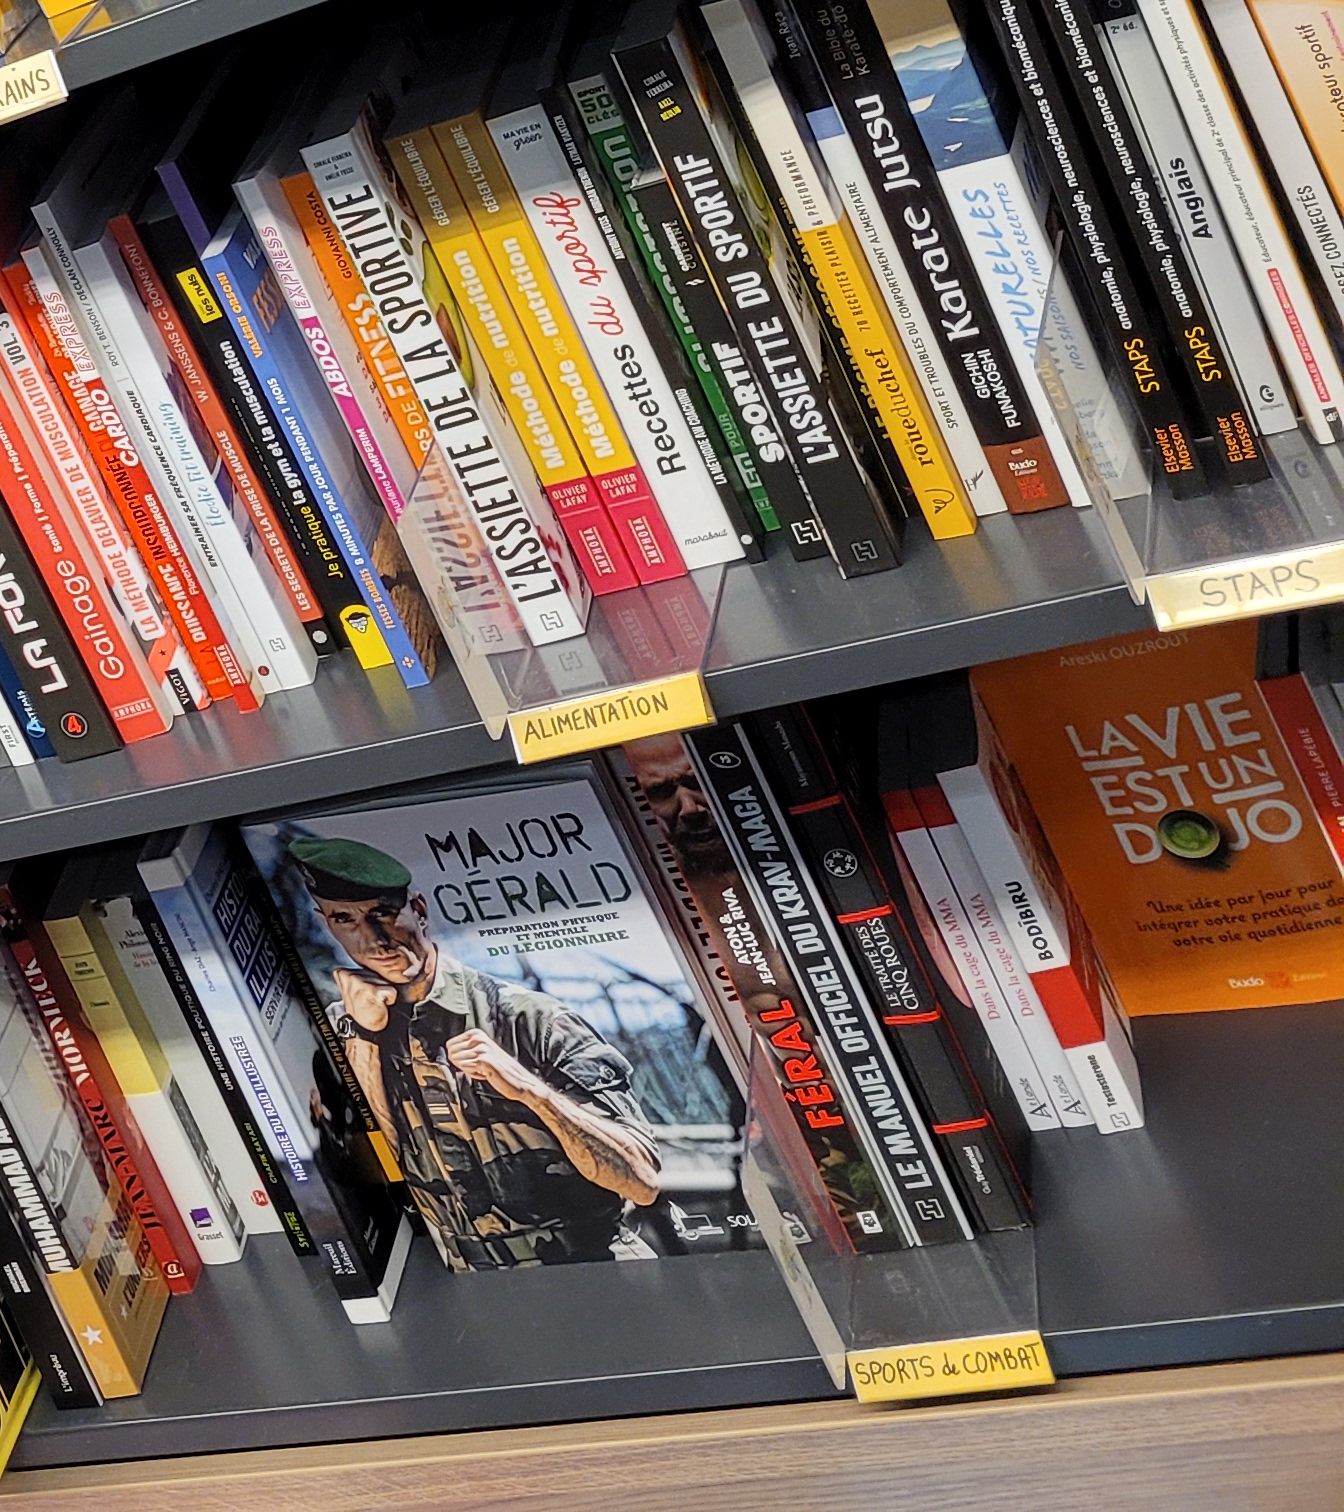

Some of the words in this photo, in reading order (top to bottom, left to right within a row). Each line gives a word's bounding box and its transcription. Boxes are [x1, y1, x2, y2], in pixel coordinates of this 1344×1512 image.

[854, 94, 913, 193] Jutsu
[533, 190, 609, 287] sportif
[677, 154, 748, 267] SPORTIF
[328, 185, 430, 343] SPORTIVE
[734, 273, 770, 310] DU
[915, 205, 981, 344] Karate
[586, 294, 625, 337] du
[410, 340, 450, 392] LA
[748, 315, 840, 464] L'ASSIETTE
[961, 351, 990, 399] GICHIN
[981, 349, 1022, 429] FUNAKOSHI
[422, 383, 479, 438] DE
[612, 343, 686, 477] Recettes
[445, 435, 554, 604] L'ASSIETTE
[1198, 558, 1321, 609] STAPS
[54, 560, 126, 681] Gainage
[23, 638, 69, 694] LA
[524, 691, 669, 744] ALIMENTATION
[1064, 720, 1140, 758] LA
[1124, 692, 1261, 760] VIE
[1090, 765, 1194, 817] EST
[1199, 749, 1278, 789] UN
[424, 811, 594, 875] MAJOR
[432, 862, 633, 927] GÉRALD
[758, 999, 845, 1130] FÉRAL
[854, 1355, 936, 1388] SPORTS
[941, 1362, 961, 1378] de
[961, 1342, 1044, 1376] COMBAT
